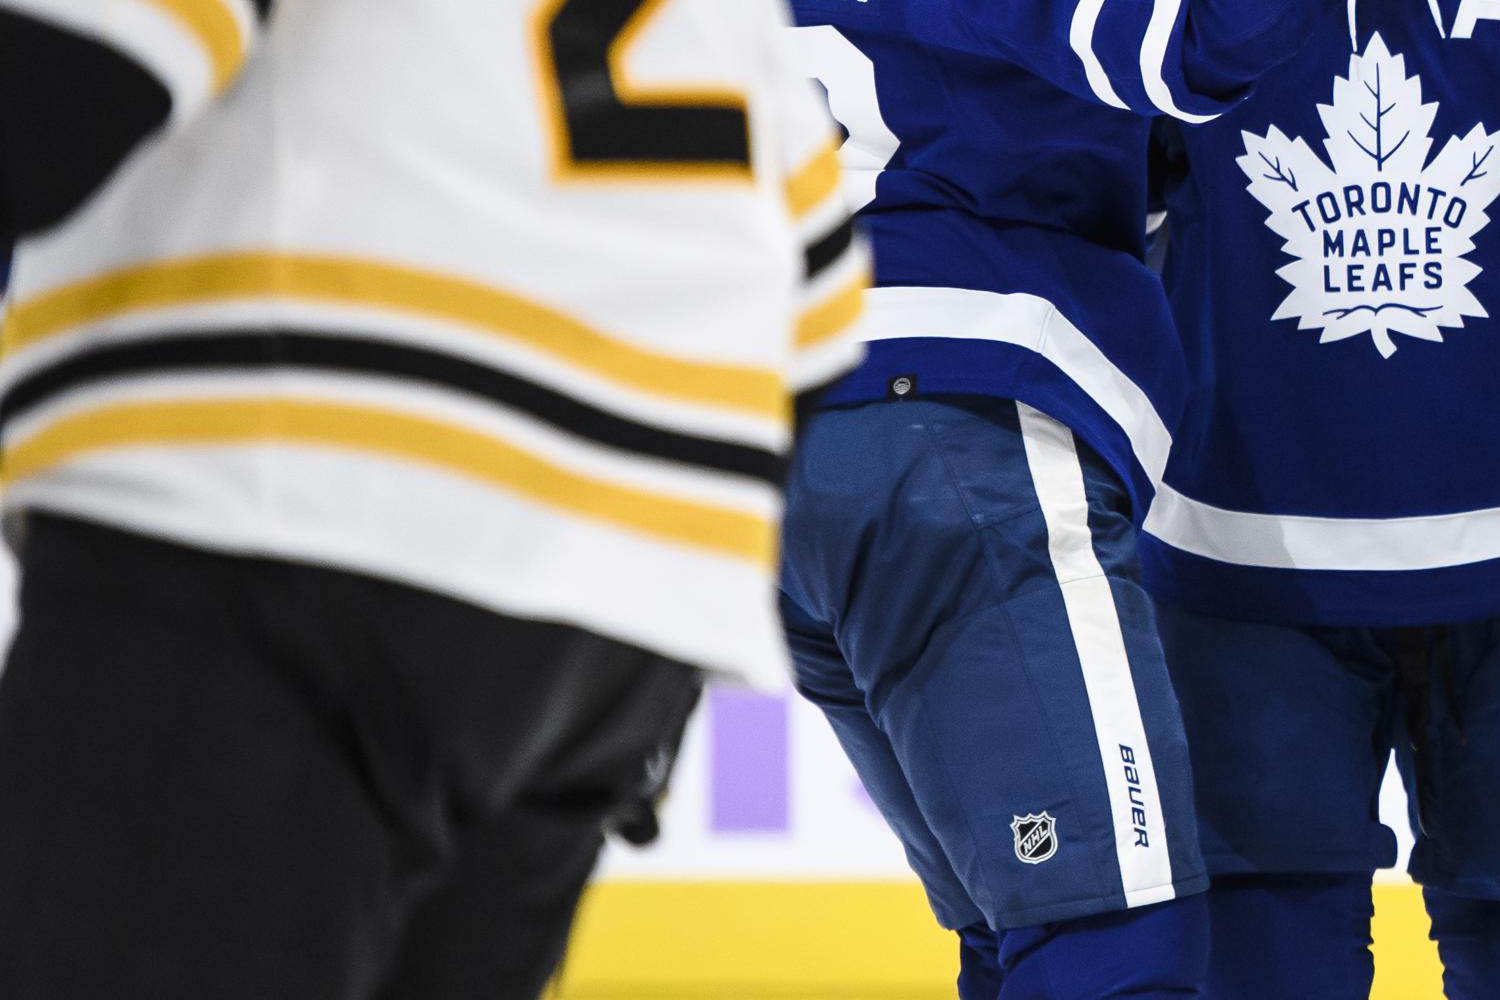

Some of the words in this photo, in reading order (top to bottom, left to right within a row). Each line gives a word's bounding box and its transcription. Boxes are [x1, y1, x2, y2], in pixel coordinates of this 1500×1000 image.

[1291, 181, 1467, 233] TORONTO
[1323, 226, 1443, 258] MAPLE
[1323, 261, 1443, 293] LEAFS
[1023, 825, 1048, 855] NHL
